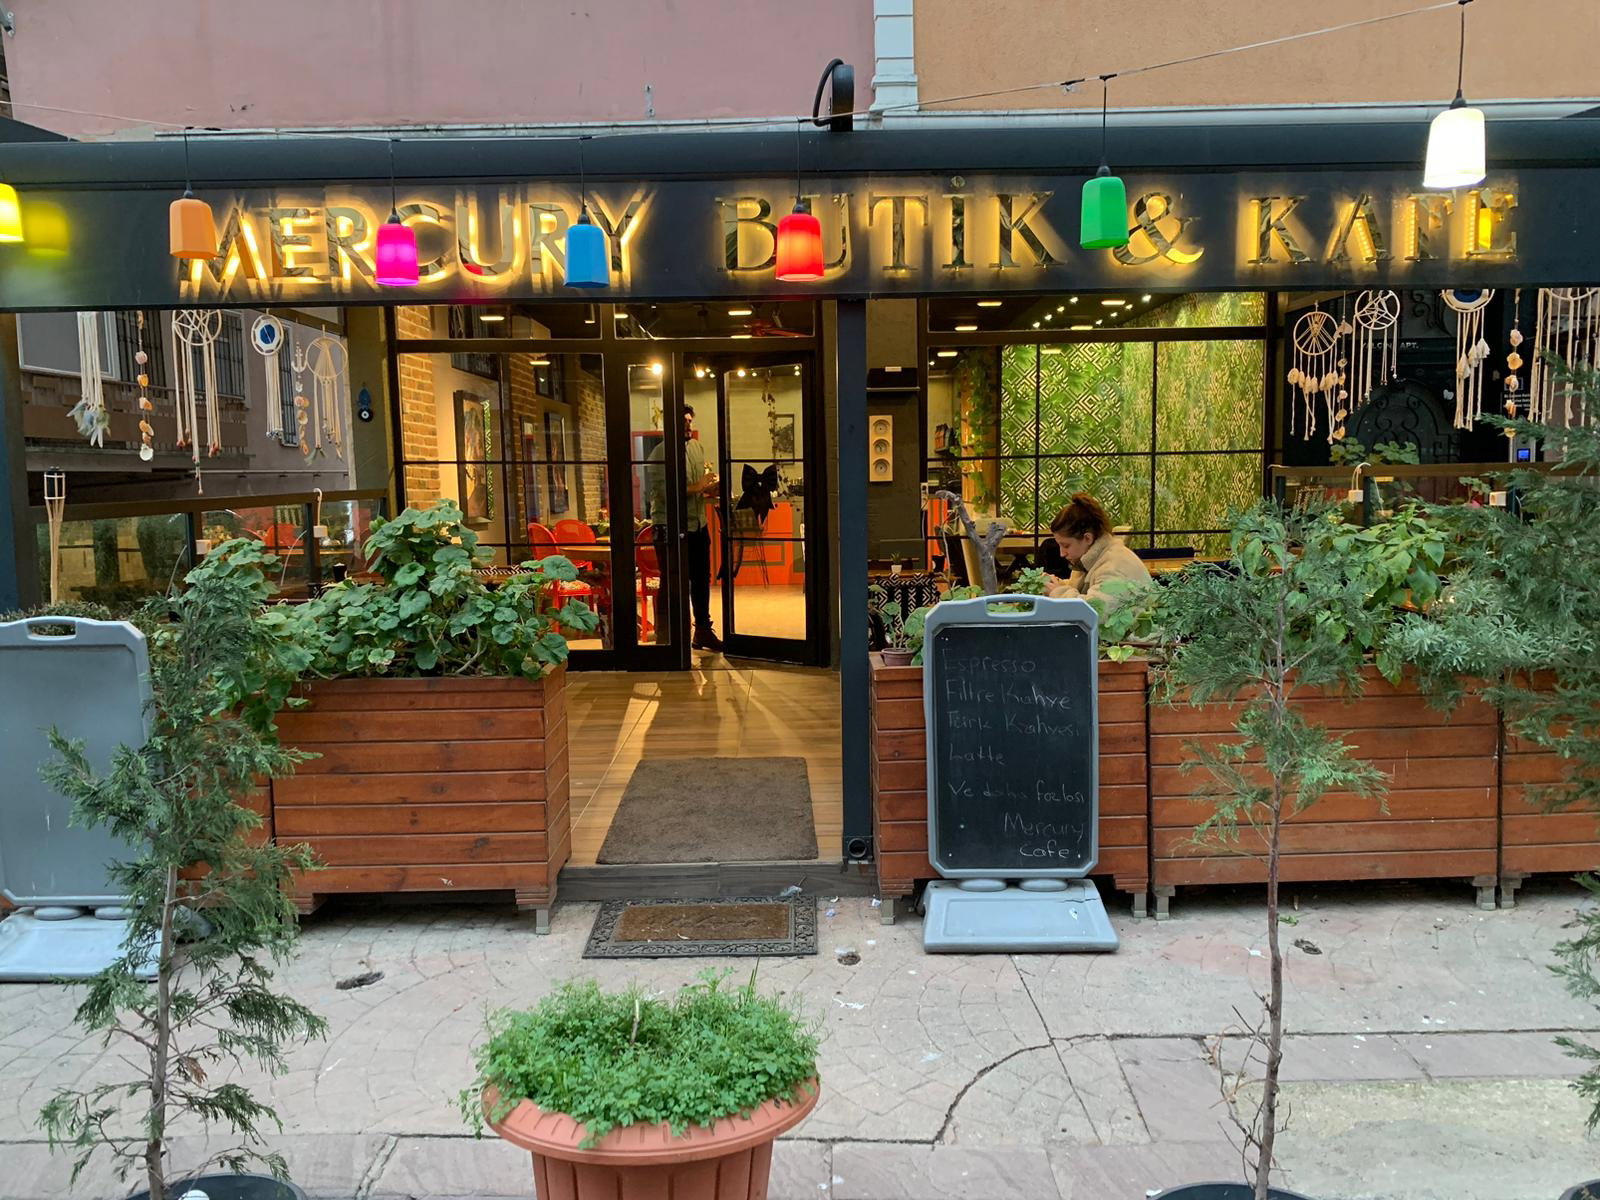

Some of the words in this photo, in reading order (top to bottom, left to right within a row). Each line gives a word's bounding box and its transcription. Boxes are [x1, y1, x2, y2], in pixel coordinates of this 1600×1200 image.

[178, 199, 644, 284] MERCURY
[1112, 192, 1204, 265] &
[1246, 188, 1519, 263] KAFE
[941, 648, 1037, 674] Espresso
[945, 679, 995, 704] Filtre
[1001, 683, 1074, 712] Kahve
[947, 779, 974, 798] Ve
[1003, 811, 1086, 844] Mercury
